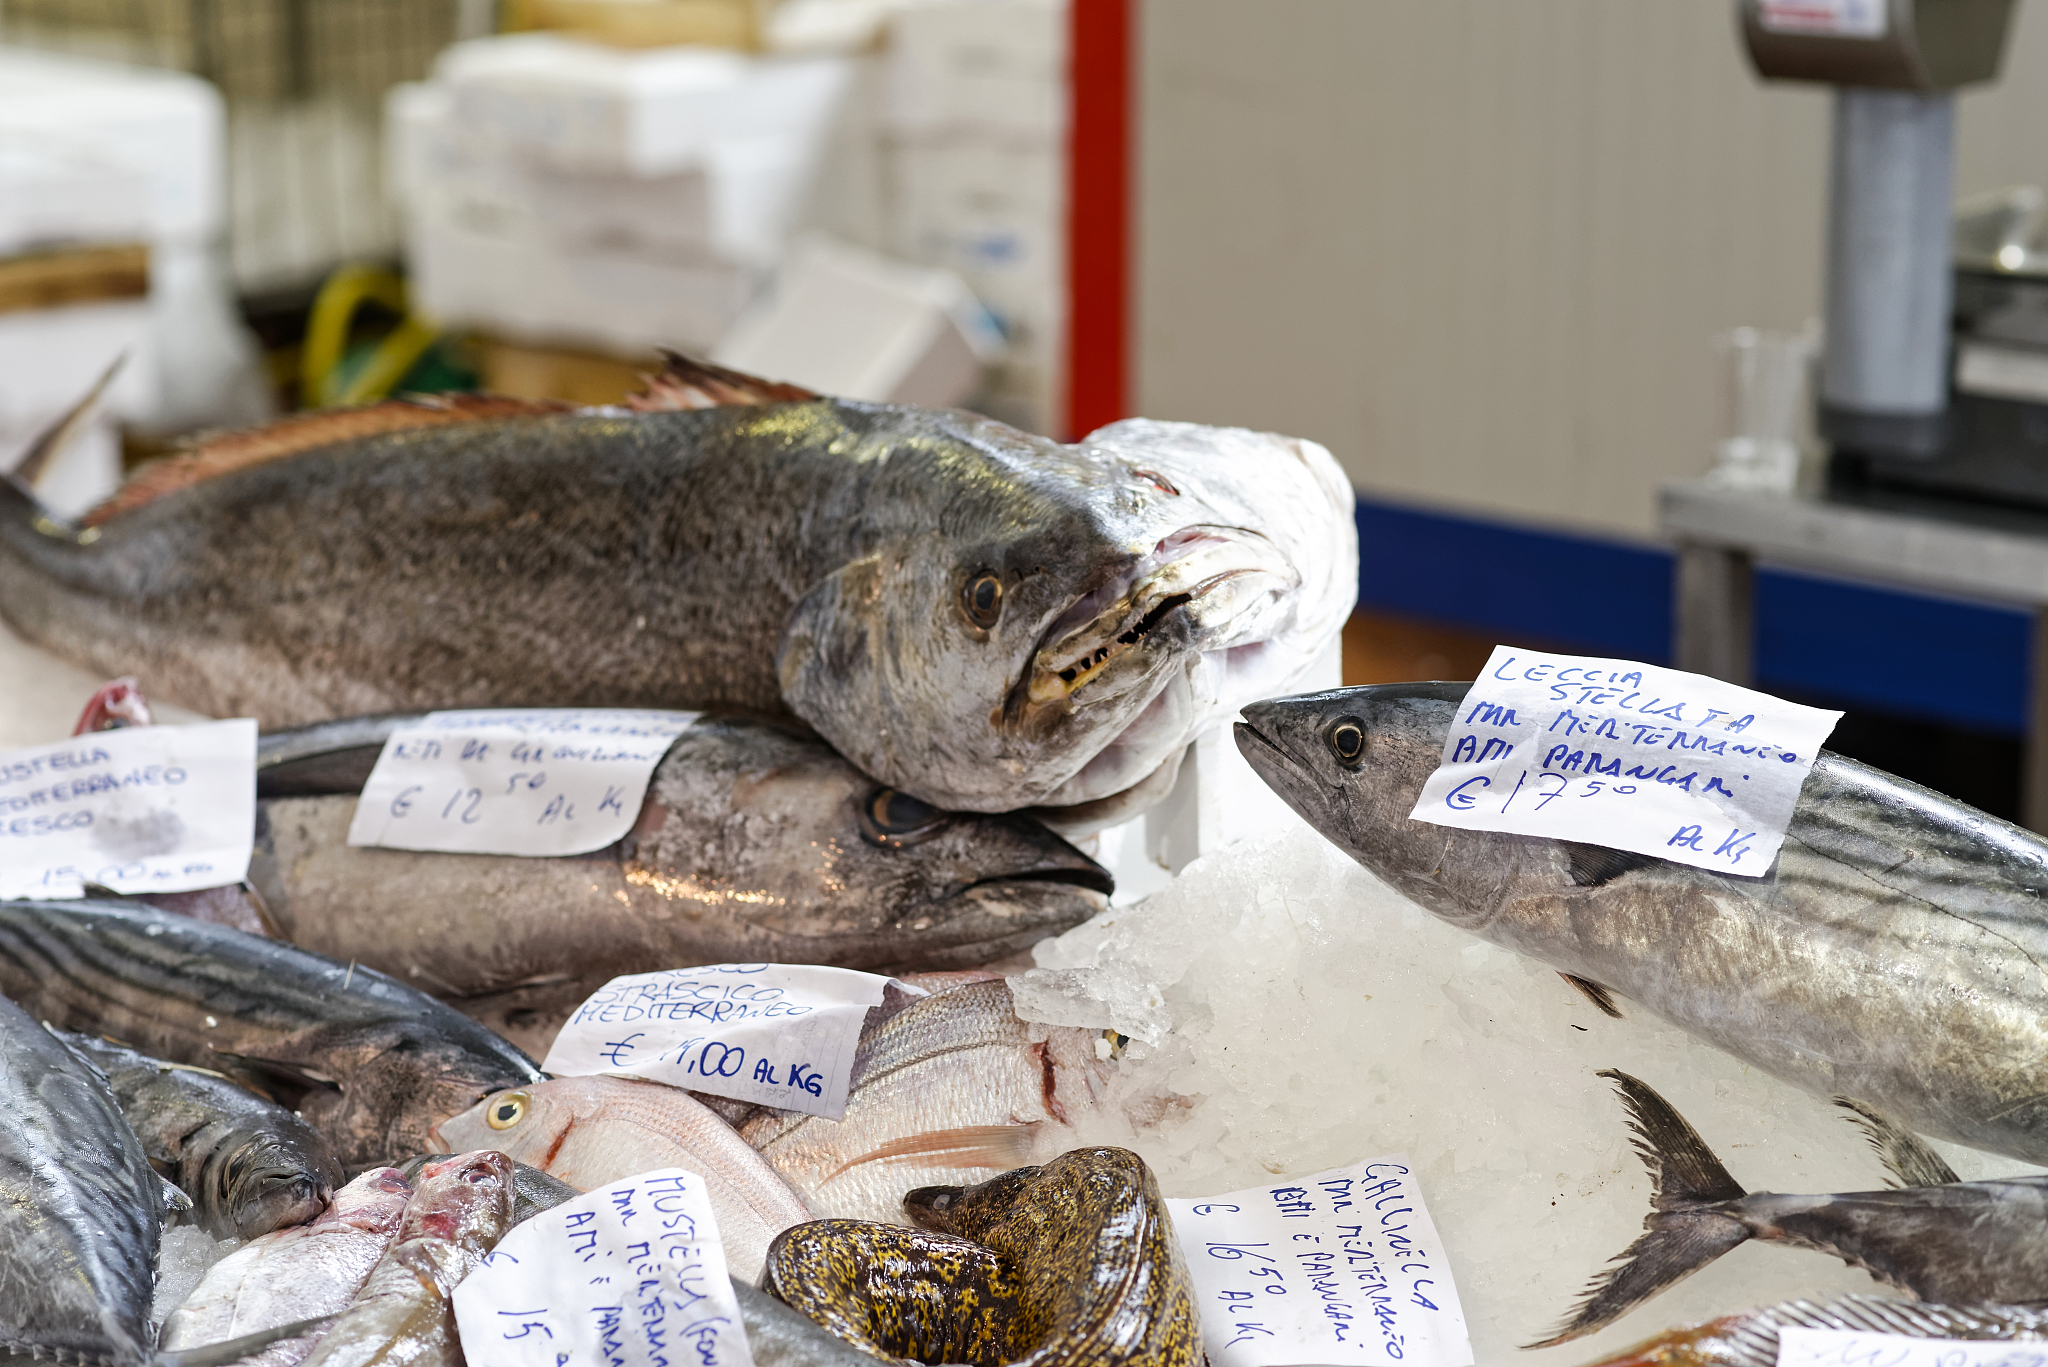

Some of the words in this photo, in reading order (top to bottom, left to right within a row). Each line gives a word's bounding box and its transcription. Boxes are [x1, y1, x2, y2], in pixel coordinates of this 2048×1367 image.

[1494, 657, 1642, 688] LECCIA
[594, 980, 784, 1004] STRASCICO
[574, 1001, 813, 1024] MEDITERRANEO
[753, 1058, 779, 1084] AL
[788, 1063, 823, 1097] KG
